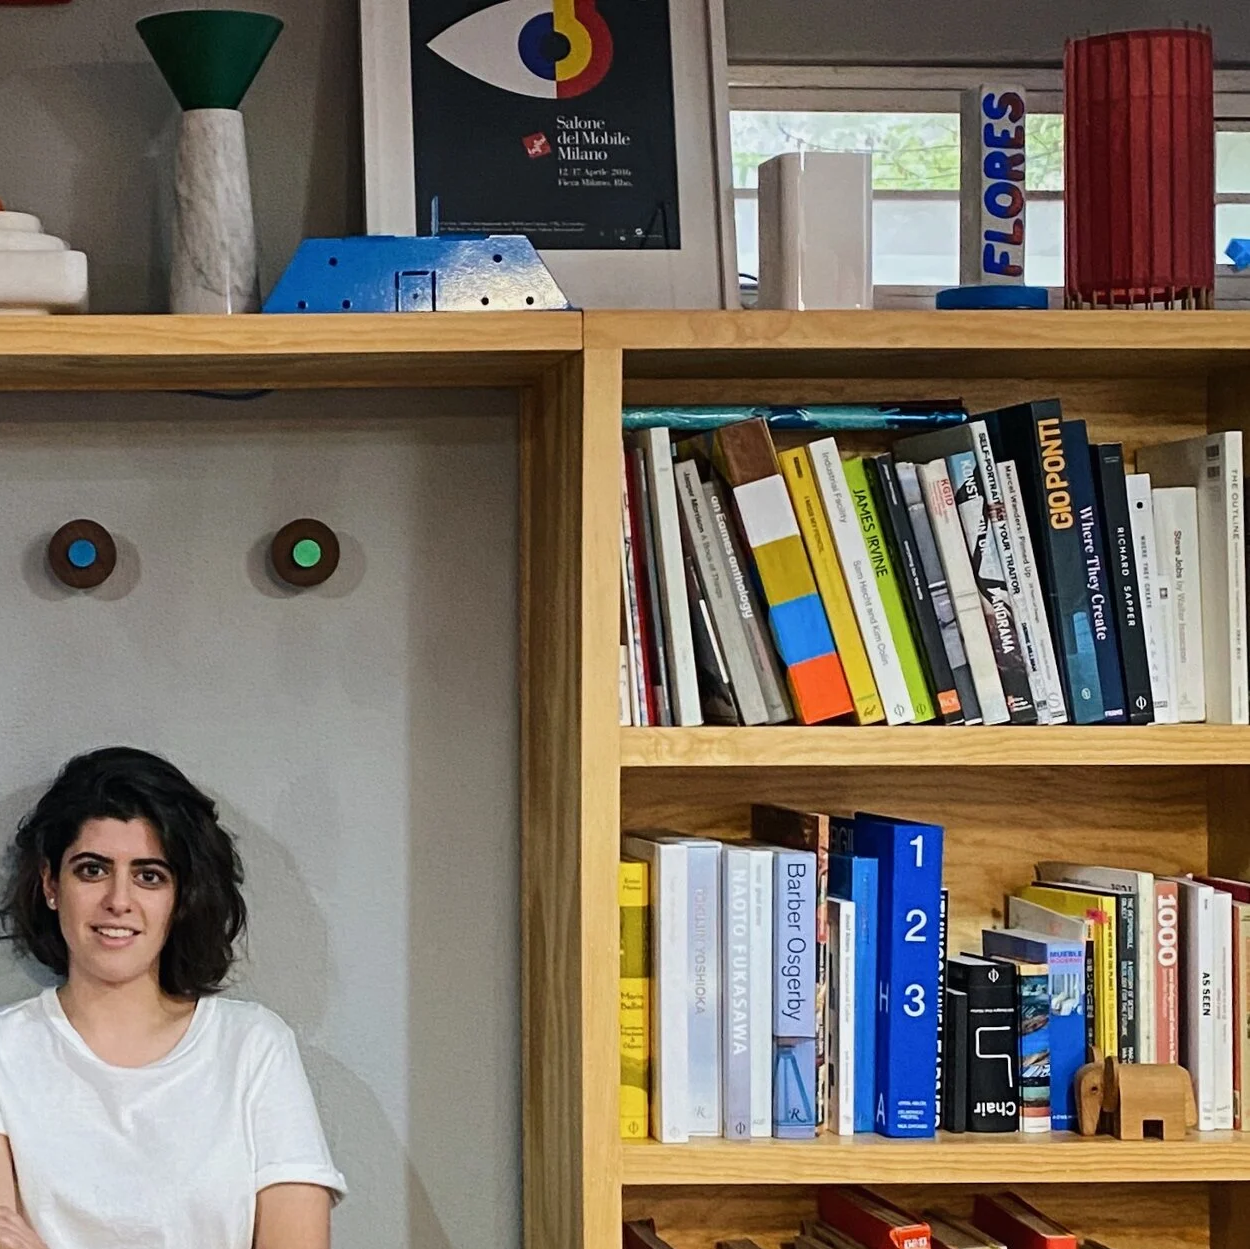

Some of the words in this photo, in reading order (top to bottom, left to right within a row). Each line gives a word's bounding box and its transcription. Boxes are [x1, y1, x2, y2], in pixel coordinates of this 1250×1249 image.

[556, 115, 605, 129] Salone
[557, 131, 579, 144] del
[581, 132, 630, 145] Mobile
[557, 146, 608, 160] Milano
[982, 92, 1025, 277] FLORES
[978, 432, 1002, 503] SELF-PORTRAIT
[1037, 417, 1068, 487] PONTI
[821, 452, 839, 491] Industrial
[832, 493, 848, 523] Facility
[941, 478, 954, 507] KGID
[1004, 465, 1016, 493] Marcel
[682, 471, 695, 498] Jasper
[690, 499, 705, 534] Morrison
[702, 542, 713, 562] Book
[710, 496, 722, 512] an
[1009, 495, 1024, 534] Wanders:
[1048, 489, 1074, 531] GIO
[1231, 493, 1240, 541] OUTLINE
[715, 514, 734, 555] Eames
[853, 488, 875, 532] JAMES
[865, 536, 888, 578] IRVINE
[999, 523, 1012, 552] YOUR
[1079, 506, 1096, 554] Where
[1140, 536, 1148, 558] WHERE
[1173, 530, 1183, 555] Steve
[1003, 554, 1021, 595] TRAITOR
[1085, 556, 1101, 593] They
[1116, 527, 1130, 577] RICHARD
[1124, 586, 1135, 627] SAPPER
[1142, 563, 1150, 580] THEY
[1175, 557, 1184, 578] Jobs
[725, 556, 753, 619] anthology
[858, 581, 873, 606] Hecht
[1144, 583, 1152, 609] CREATE
[1175, 581, 1185, 591] by
[865, 608, 877, 624] and
[987, 587, 1015, 653] PANORAMA
[1090, 594, 1108, 641] Create
[1176, 593, 1187, 621] Walter
[869, 625, 882, 642] Kim
[875, 644, 889, 666] Colin
[909, 835, 924, 867] 1
[694, 888, 707, 941] TOKUJIN
[732, 869, 748, 936] NAOTO
[787, 863, 807, 931] Barber
[904, 909, 927, 942] 2
[1157, 894, 1177, 967] 1000
[694, 946, 707, 1015] YOSHIOKA
[781, 937, 806, 1021] Osgerby
[1202, 973, 1210, 987] AS
[732, 945, 748, 1054] FUKASAWA
[903, 984, 926, 1017] 3
[1202, 989, 1211, 1017] SEEN
[974, 1101, 1016, 1117] Chair
